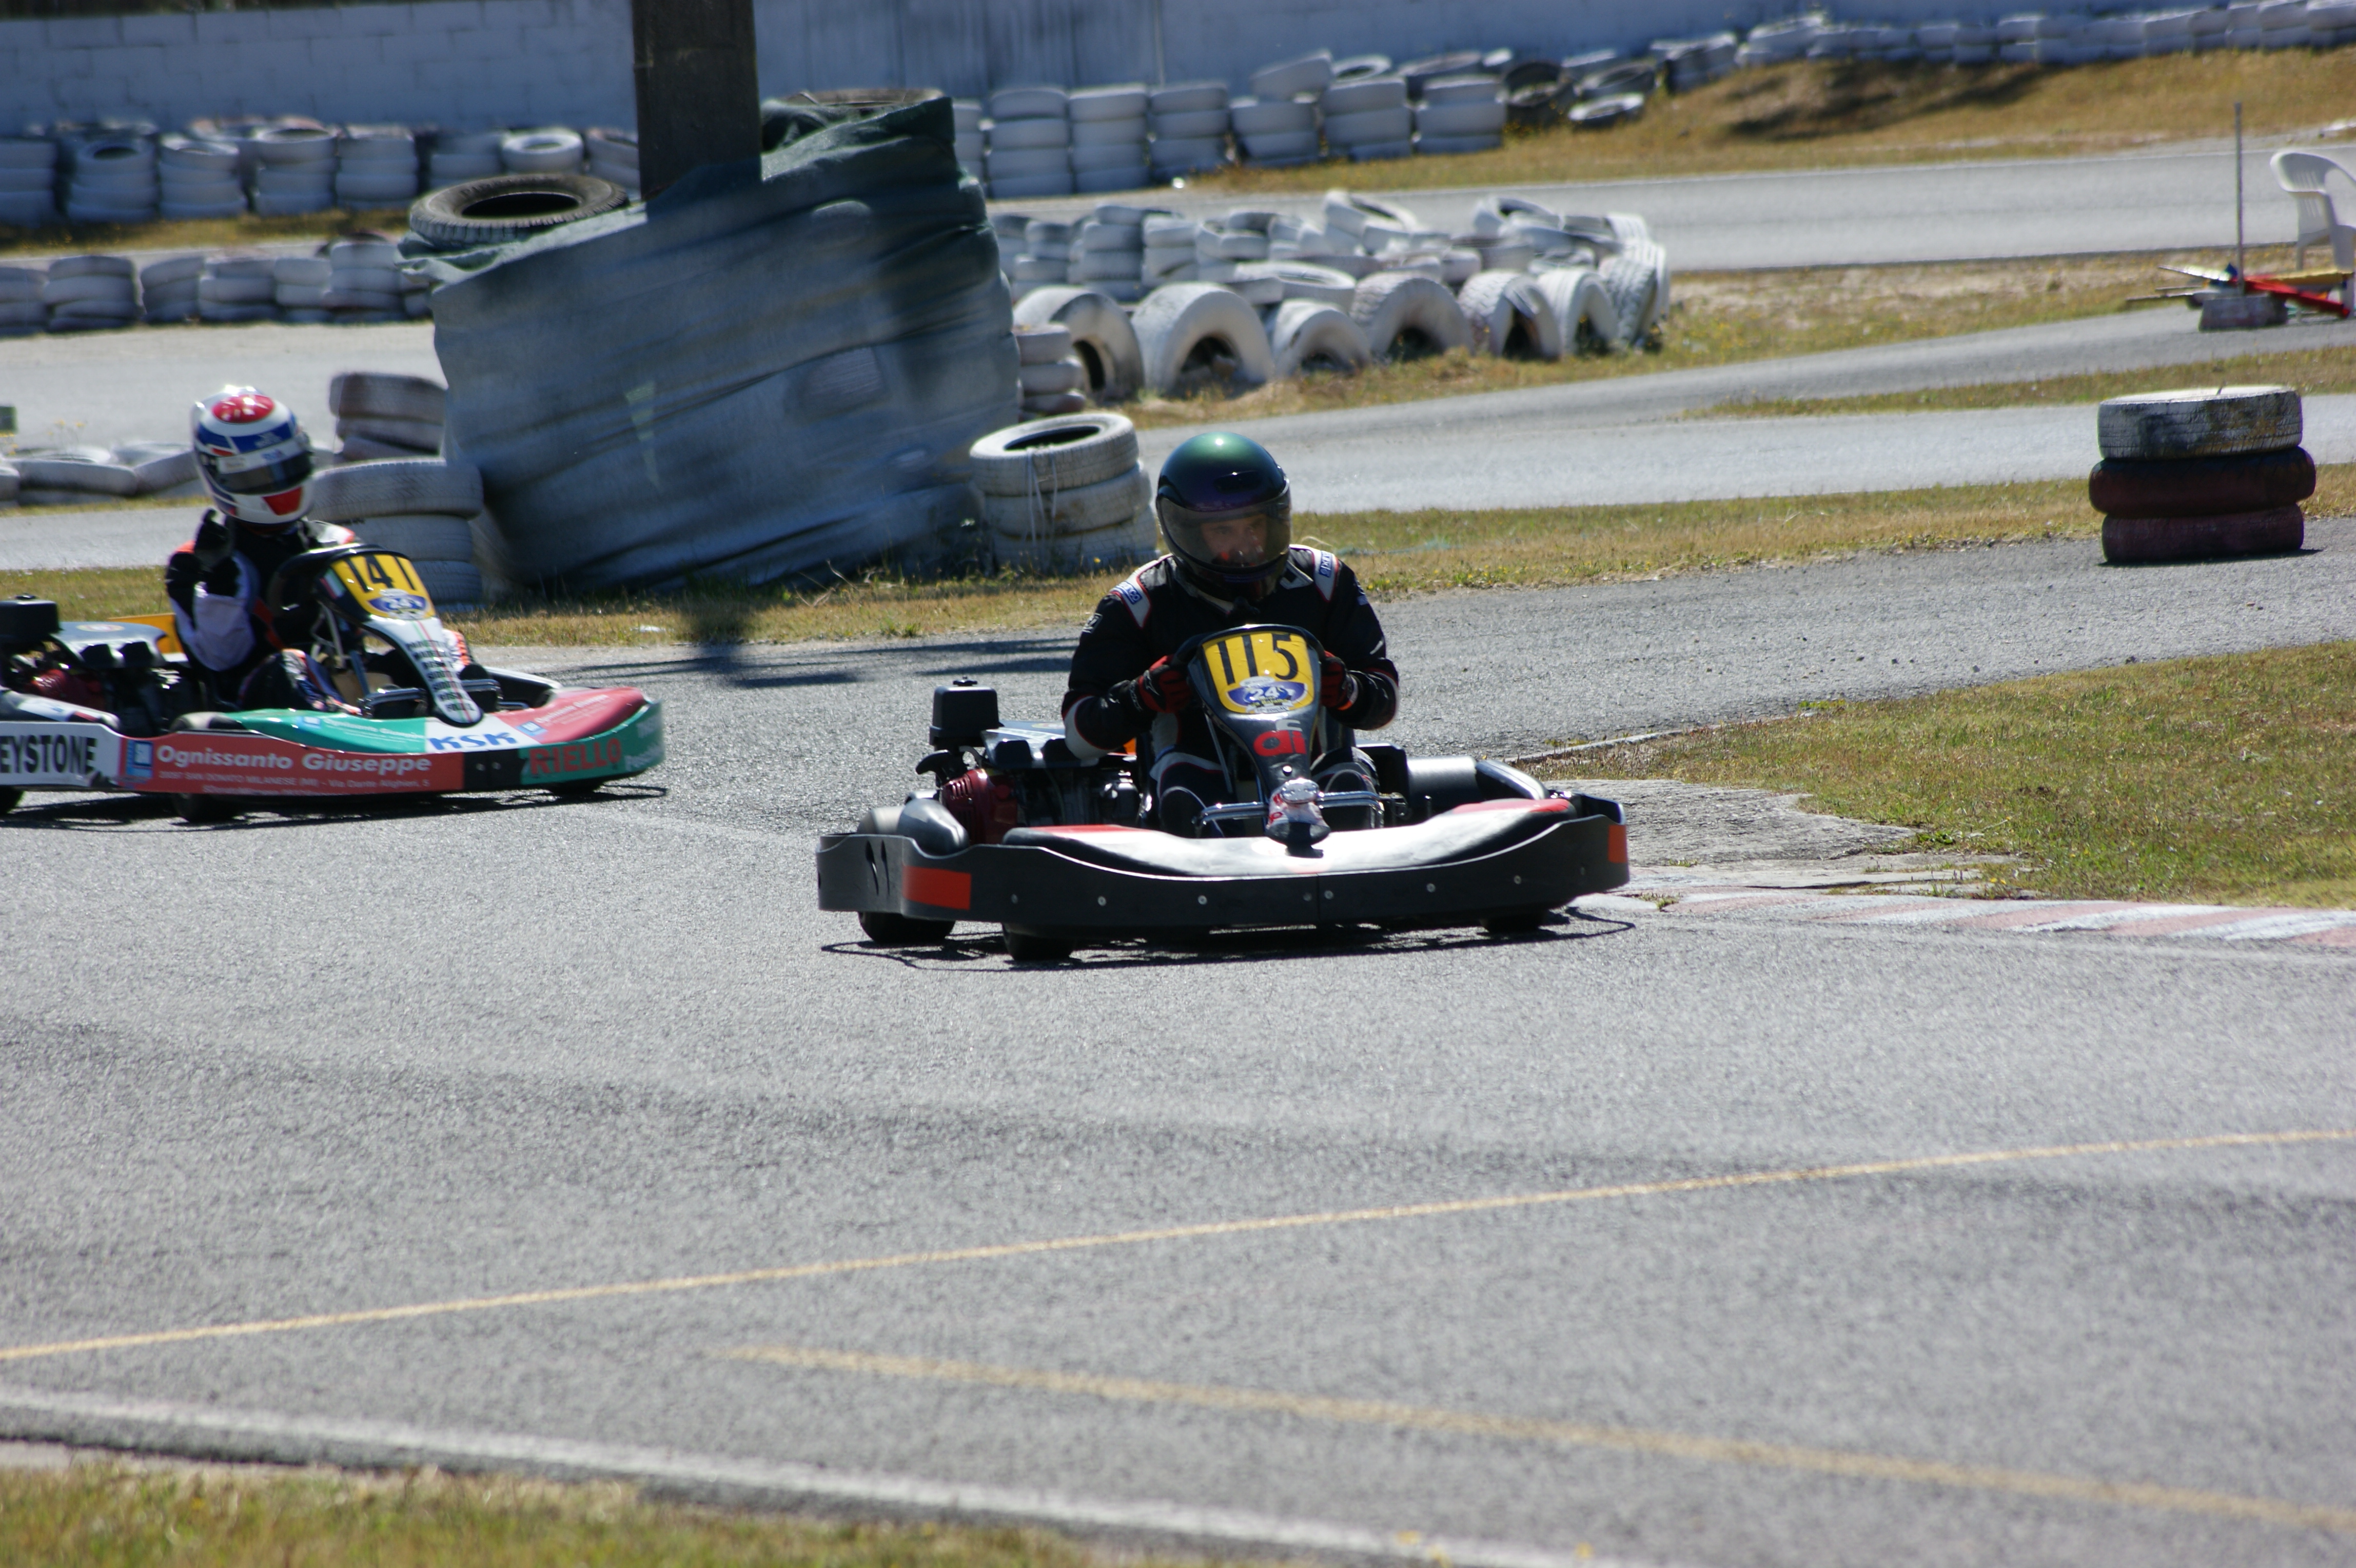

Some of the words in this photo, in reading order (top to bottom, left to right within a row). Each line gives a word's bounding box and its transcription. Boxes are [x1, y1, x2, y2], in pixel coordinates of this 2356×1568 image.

[344, 554, 416, 593] 141
[1218, 633, 1298, 685] 115
[1250, 686, 1280, 700] 24
[428, 732, 517, 750] KSK
[529, 738, 621, 774] RIELLO
[157, 745, 293, 769] Ognissanto
[302, 753, 432, 776] Giuseppe
